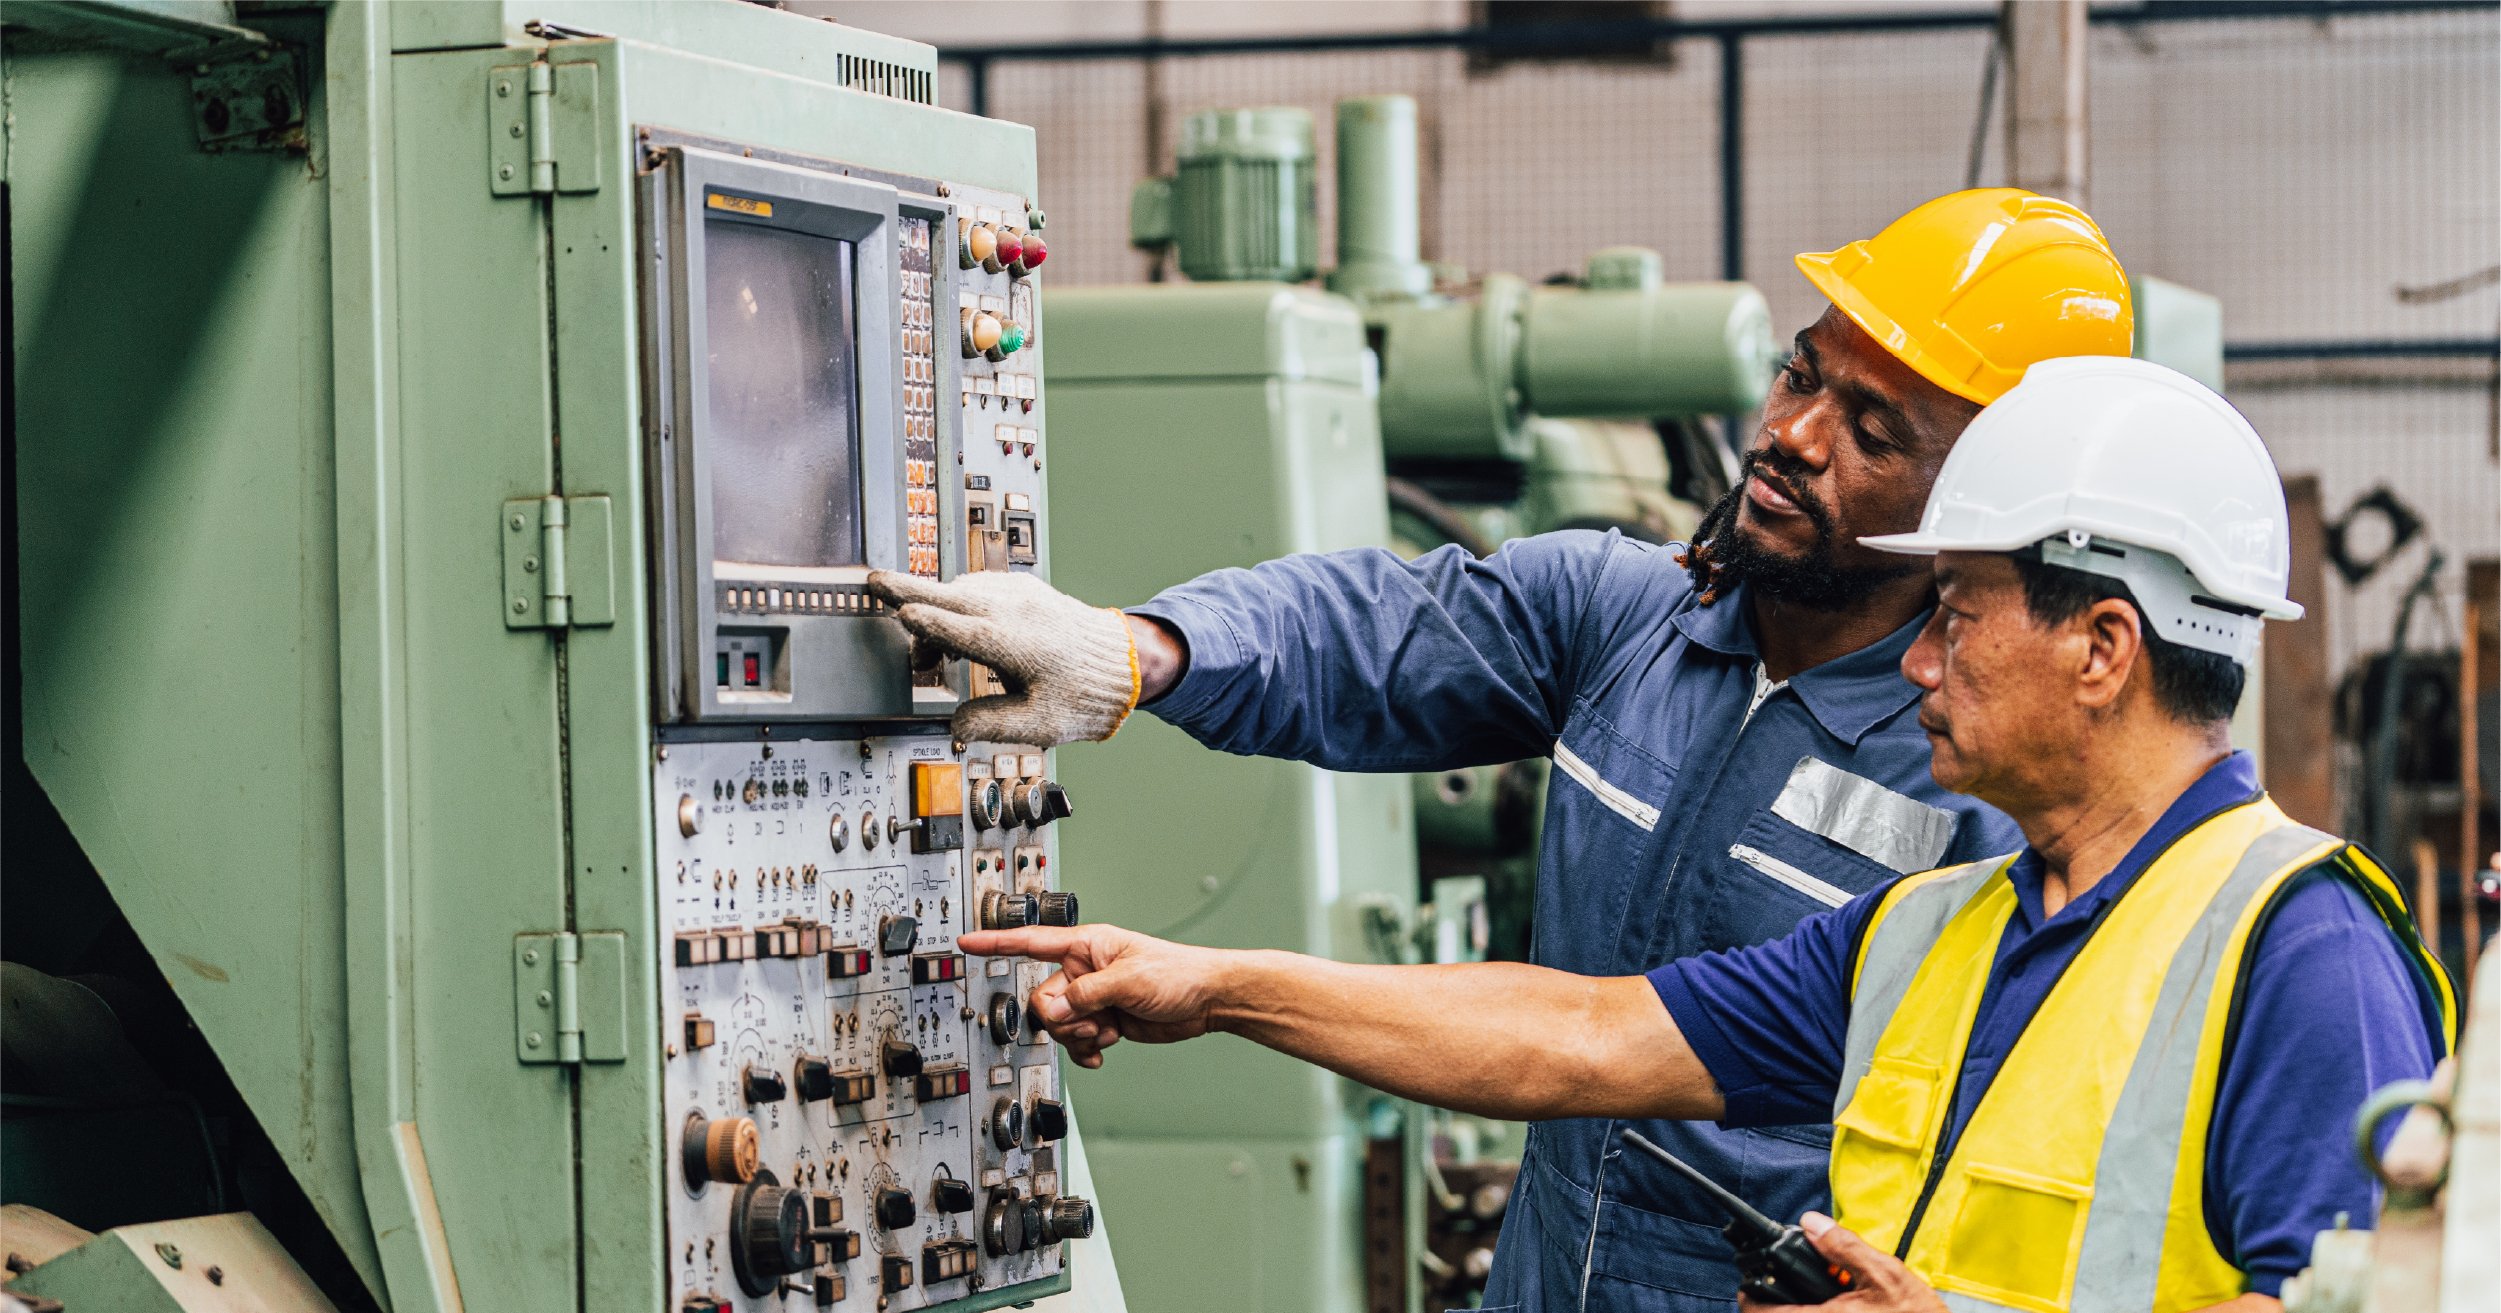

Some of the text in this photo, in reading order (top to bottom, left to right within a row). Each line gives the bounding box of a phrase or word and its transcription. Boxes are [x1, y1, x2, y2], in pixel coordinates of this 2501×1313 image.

[912, 747, 940, 757] SPINDLE LOAD
[927, 936, 937, 945] STOP
[939, 935, 950, 944] BACK
